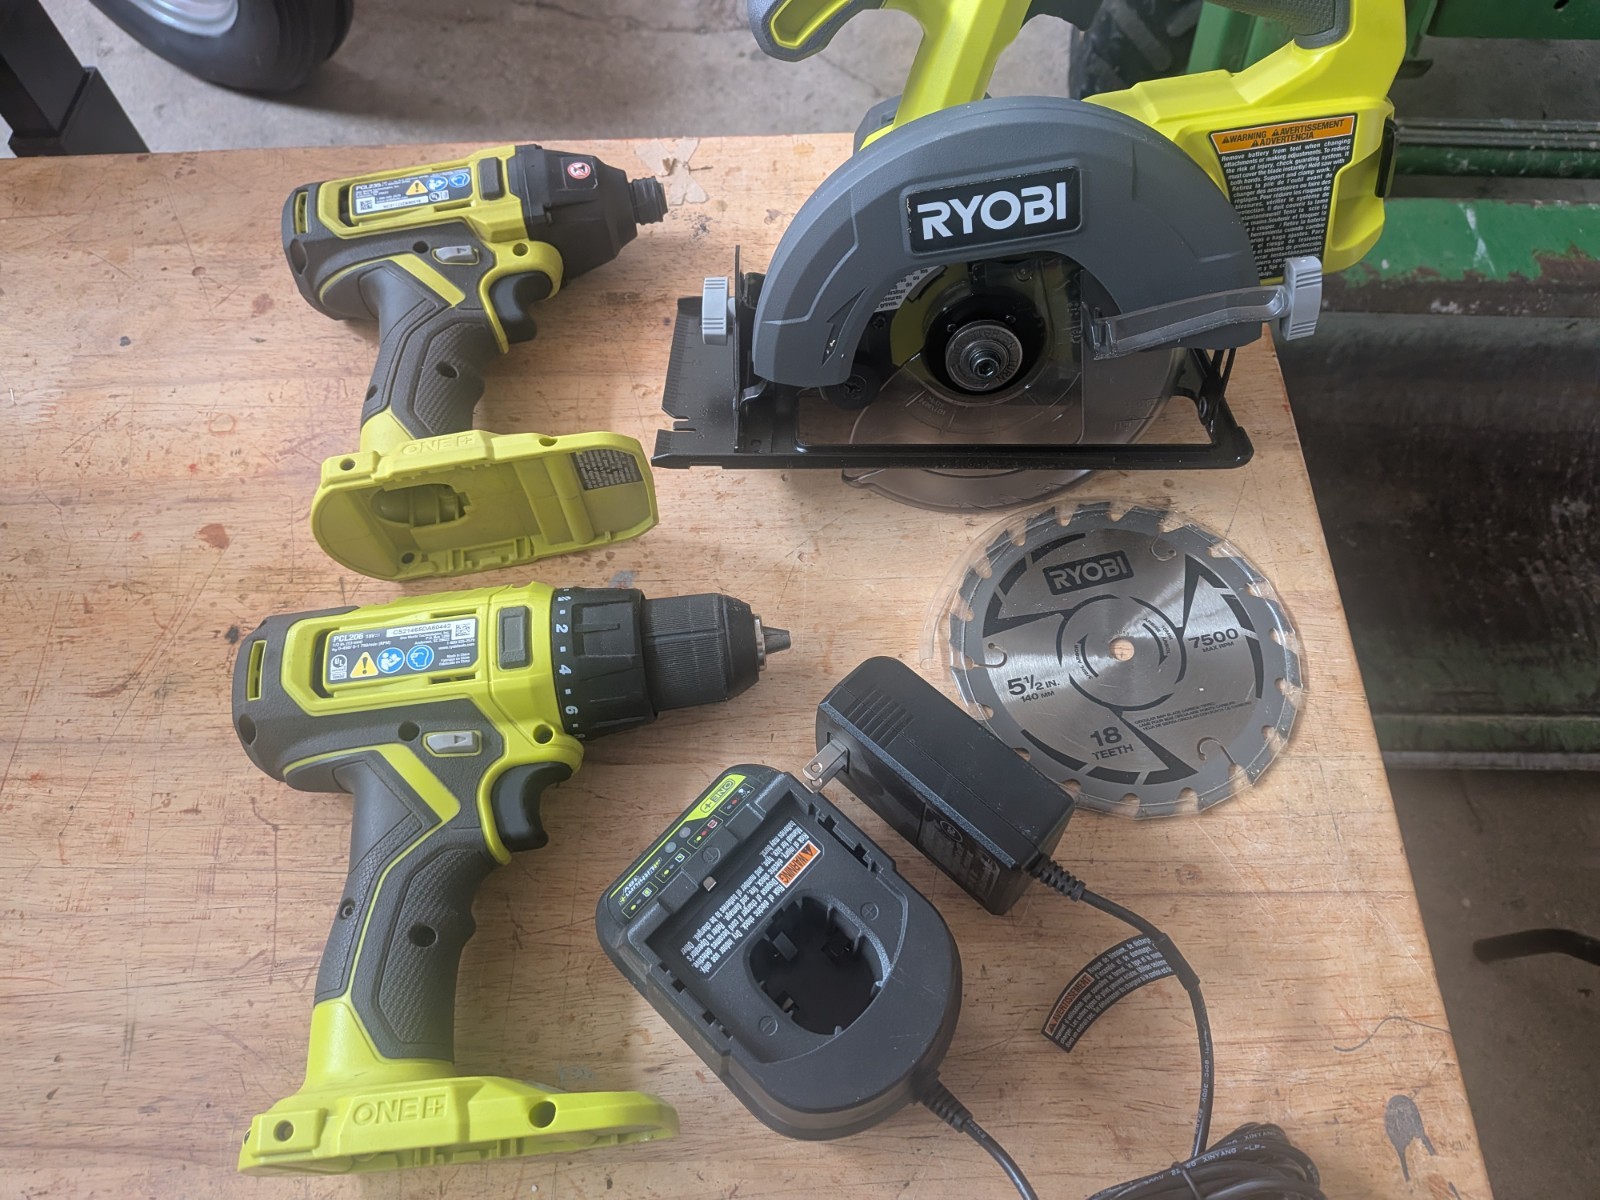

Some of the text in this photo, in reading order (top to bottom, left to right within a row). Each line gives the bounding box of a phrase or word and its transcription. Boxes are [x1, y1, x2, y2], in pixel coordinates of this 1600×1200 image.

[1279, 119, 1344, 135] AVERTISSEMENT
[1228, 131, 1267, 142] WARNING
[1259, 132, 1313, 146] ADVERTENCIA
[1247, 150, 1269, 158] battery
[1323, 137, 1351, 148] changing
[917, 182, 1067, 240] RYOBI
[1049, 555, 1129, 589] RYOBI
[333, 631, 364, 643] PCL206
[556, 624, 568, 633] 2
[1189, 628, 1238, 650] 7500
[1202, 640, 1234, 653] MAX RPM
[559, 665, 571, 675] 4
[1044, 679, 1060, 690] IN.
[1020, 690, 1055, 702] 140 MM
[566, 706, 578, 715] 6
[1090, 727, 1122, 746] 18
[1092, 744, 1133, 760] TEETH
[758, 819, 796, 859] batteries may burst.
[777, 852, 808, 884] WARNING
[679, 825, 802, 956] Manual for size, type, and number of batteries to be charged. Other
[684, 831, 809, 963] Risk of injury, electric shock, fire, and damage. Refer to Operator's
[691, 876, 778, 970] Dispose of charger if cord becomes defective.
[697, 883, 785, 974] Risk of electric shock. Dry indoor use only.
[1053, 975, 1092, 1021] AVERTISSEMENT
[1203, 1148, 1236, 1162] XINYANG
